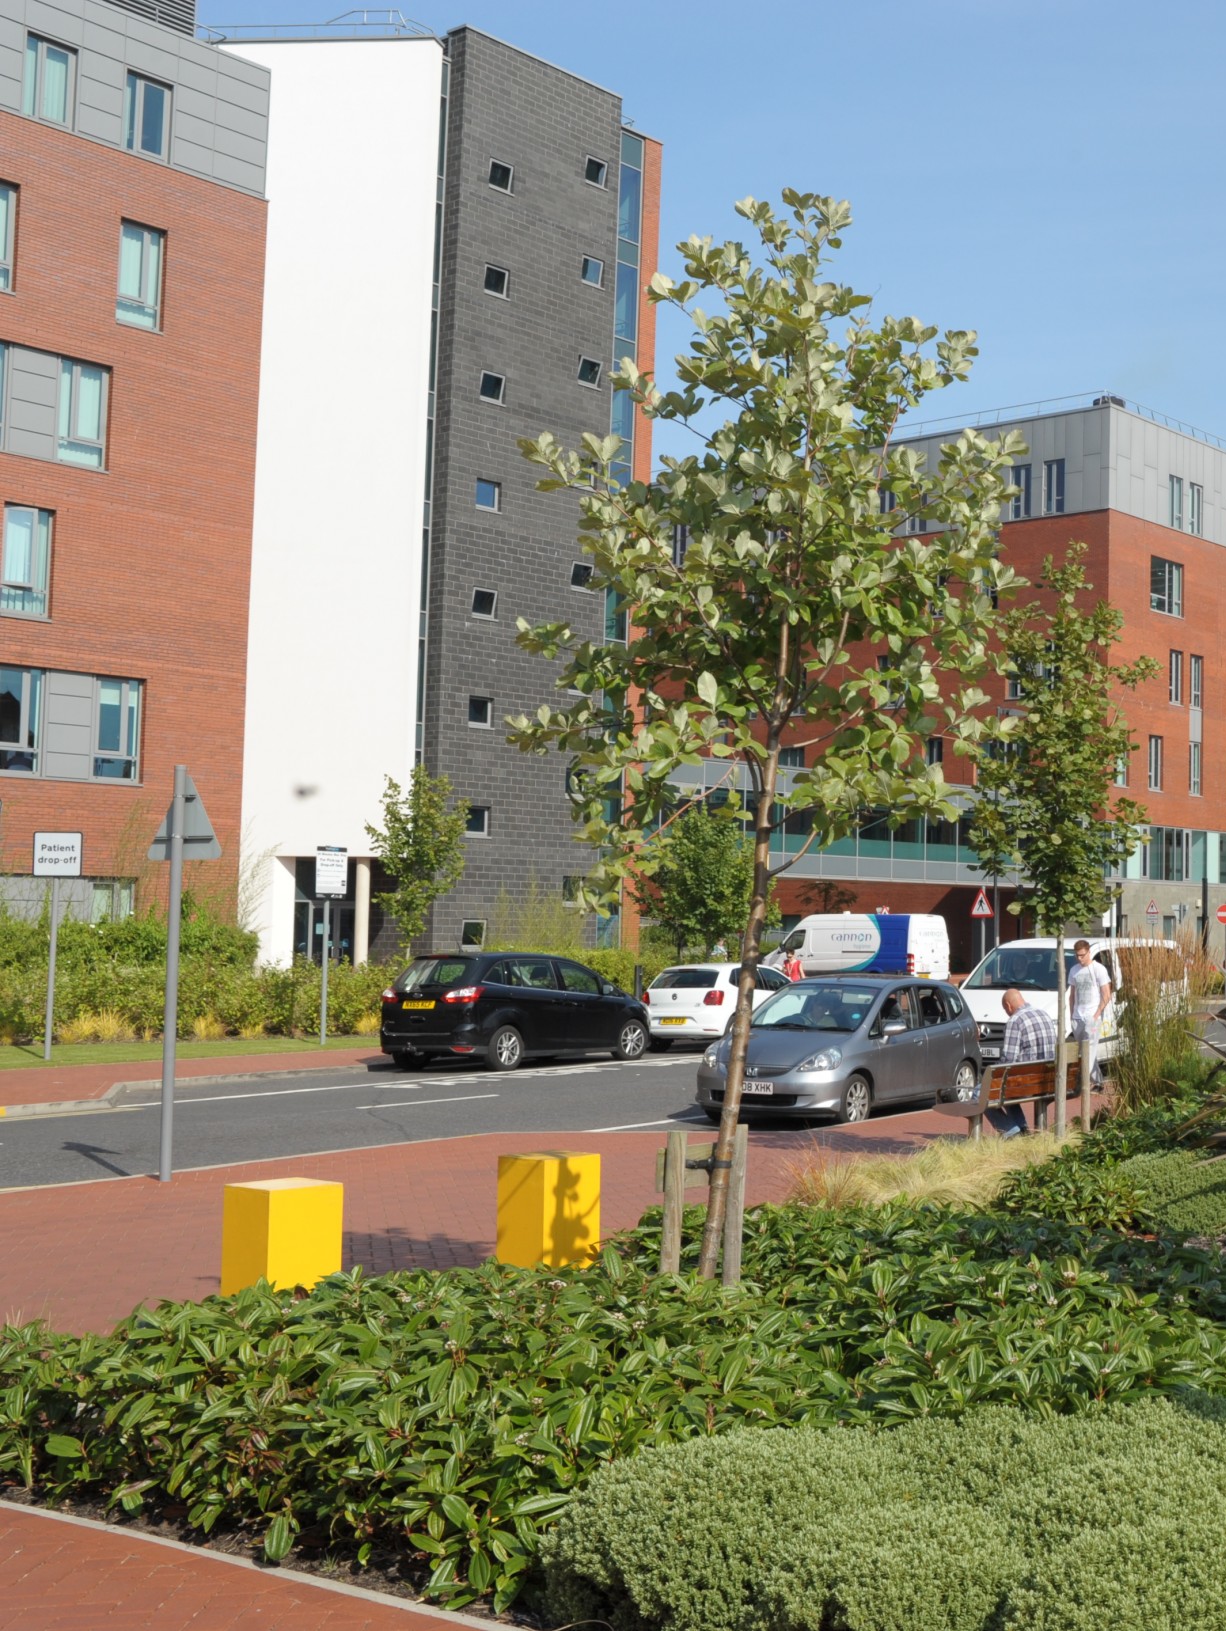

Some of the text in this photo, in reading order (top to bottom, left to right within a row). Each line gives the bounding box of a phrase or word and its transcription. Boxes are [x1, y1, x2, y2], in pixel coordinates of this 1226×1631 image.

[41, 844, 75, 852] Patient
[37, 856, 77, 865] drop-off
[831, 932, 872, 942] cannon
[754, 1082, 772, 1092] XHK
